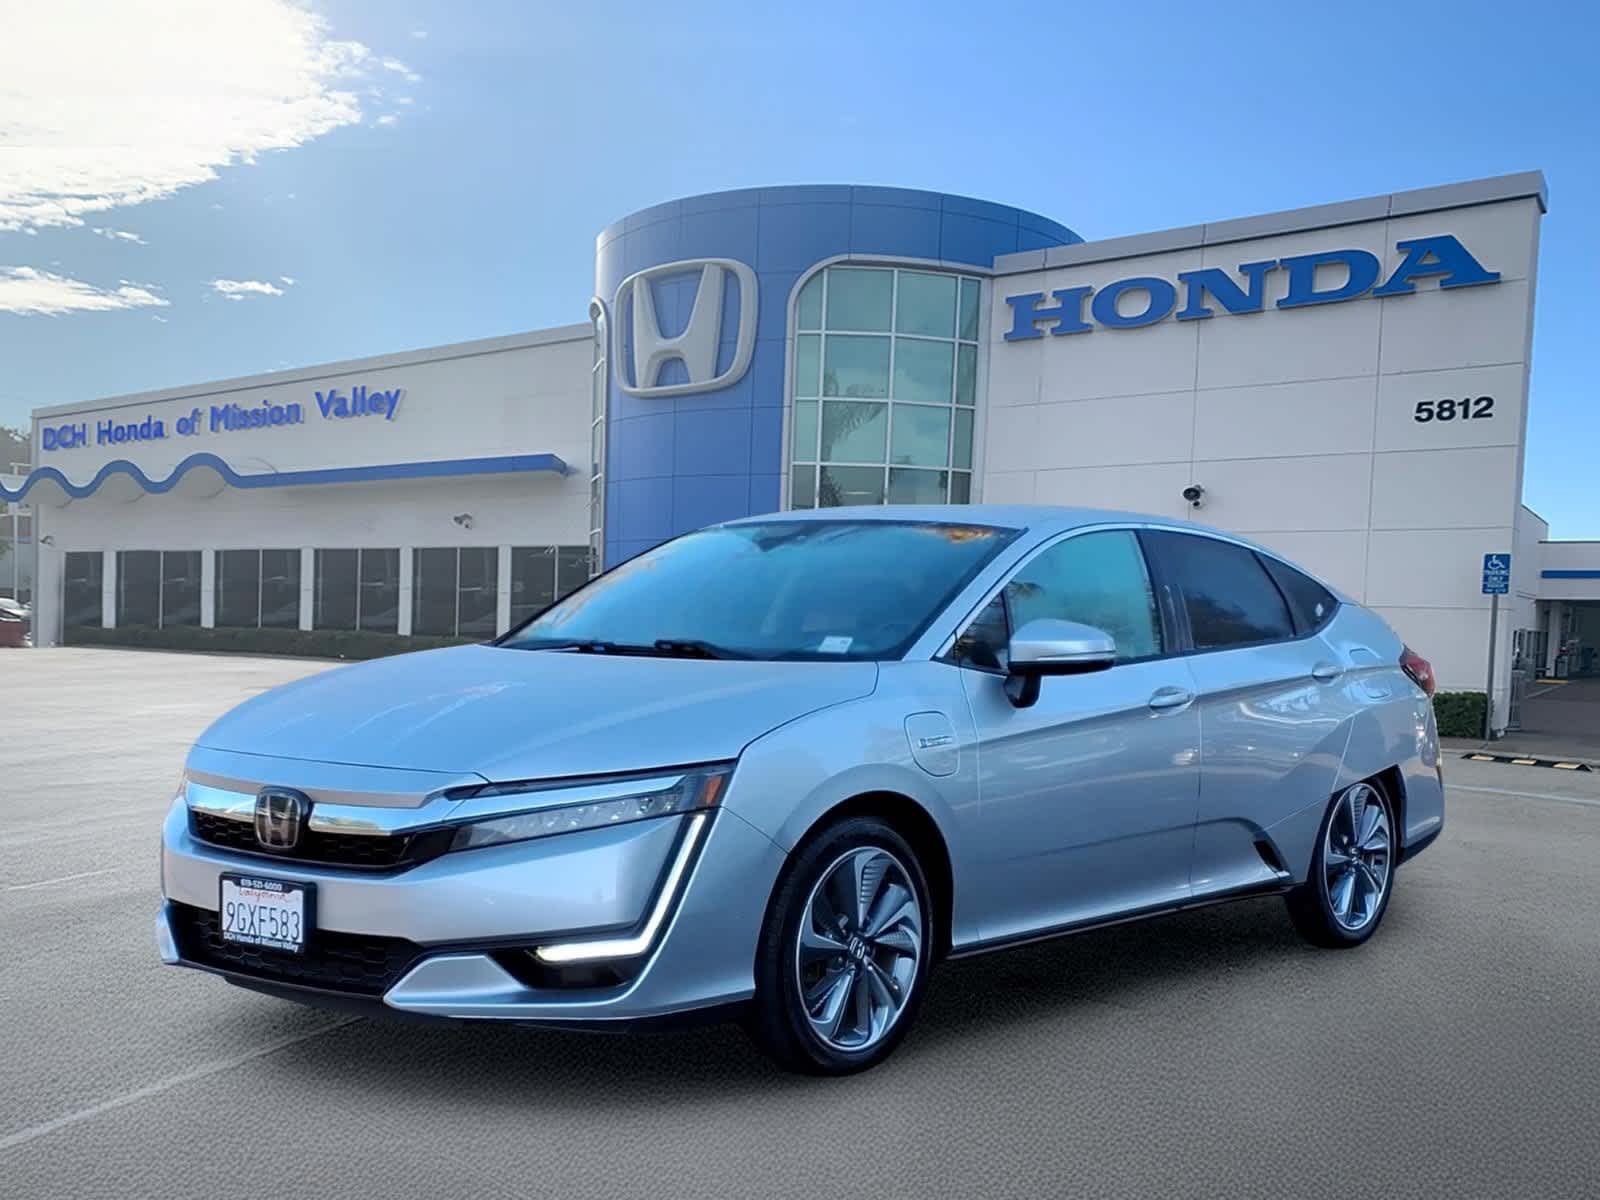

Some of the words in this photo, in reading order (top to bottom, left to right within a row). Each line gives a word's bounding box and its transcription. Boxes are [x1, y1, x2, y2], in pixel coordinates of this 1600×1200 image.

[1004, 234, 1501, 341] HONDA
[42, 423, 86, 451] DCH
[97, 415, 164, 445] Honda
[176, 408, 202, 436] of
[210, 399, 302, 432] Mission
[315, 385, 402, 421] Valley
[1414, 396, 1494, 423] 5812
[226, 901, 300, 941] 9GXF583
